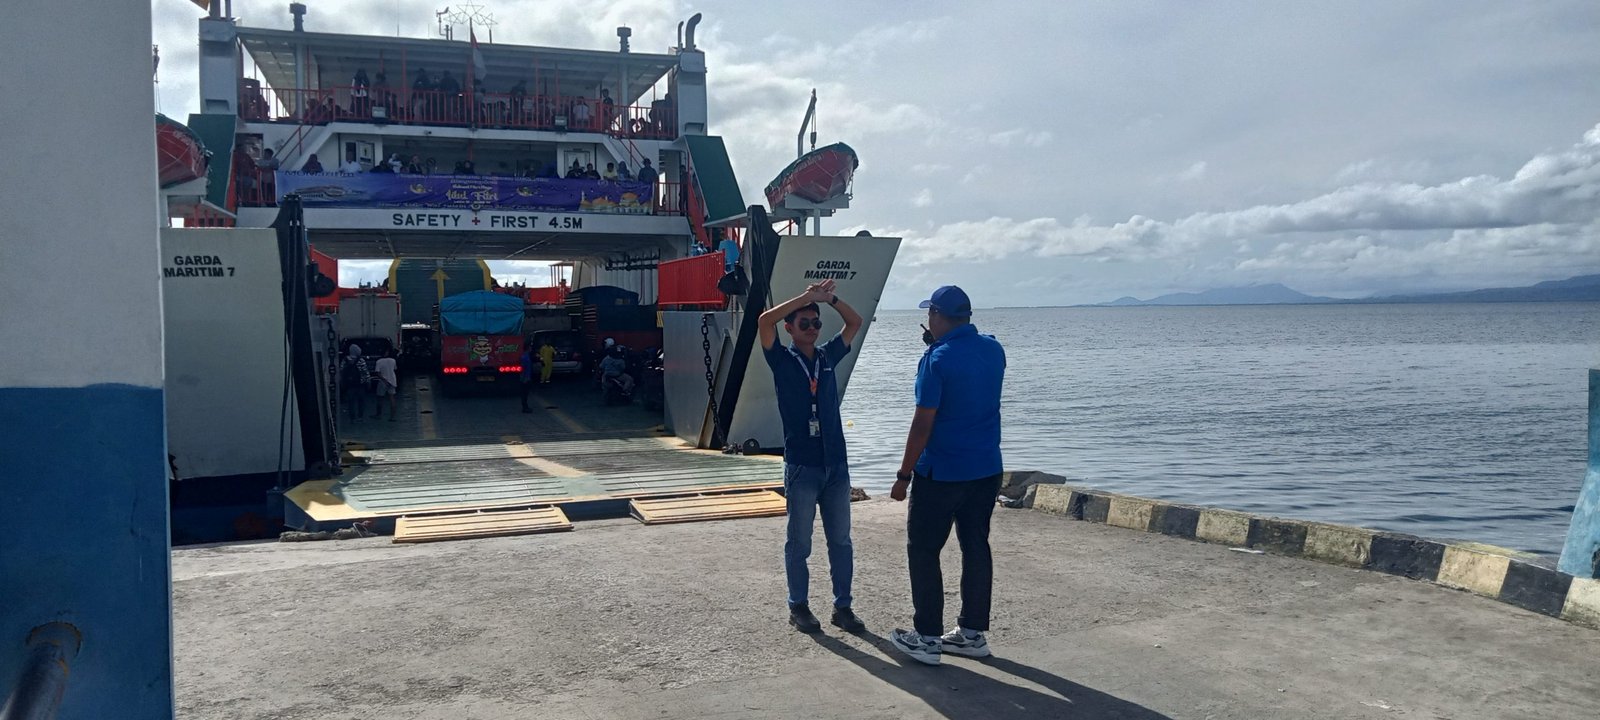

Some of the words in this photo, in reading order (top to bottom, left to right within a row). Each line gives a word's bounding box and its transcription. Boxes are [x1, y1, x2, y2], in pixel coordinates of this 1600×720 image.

[392, 213, 461, 227] SAFETY
[490, 215, 539, 228] FIRST
[548, 216, 583, 229] 4.5M
[174, 255, 222, 266] GARDA
[816, 260, 851, 270] GARDA
[163, 267, 224, 278] MARITIM
[227, 267, 235, 277] 7
[804, 270, 848, 279] MARITIM
[849, 271, 857, 280] 7
